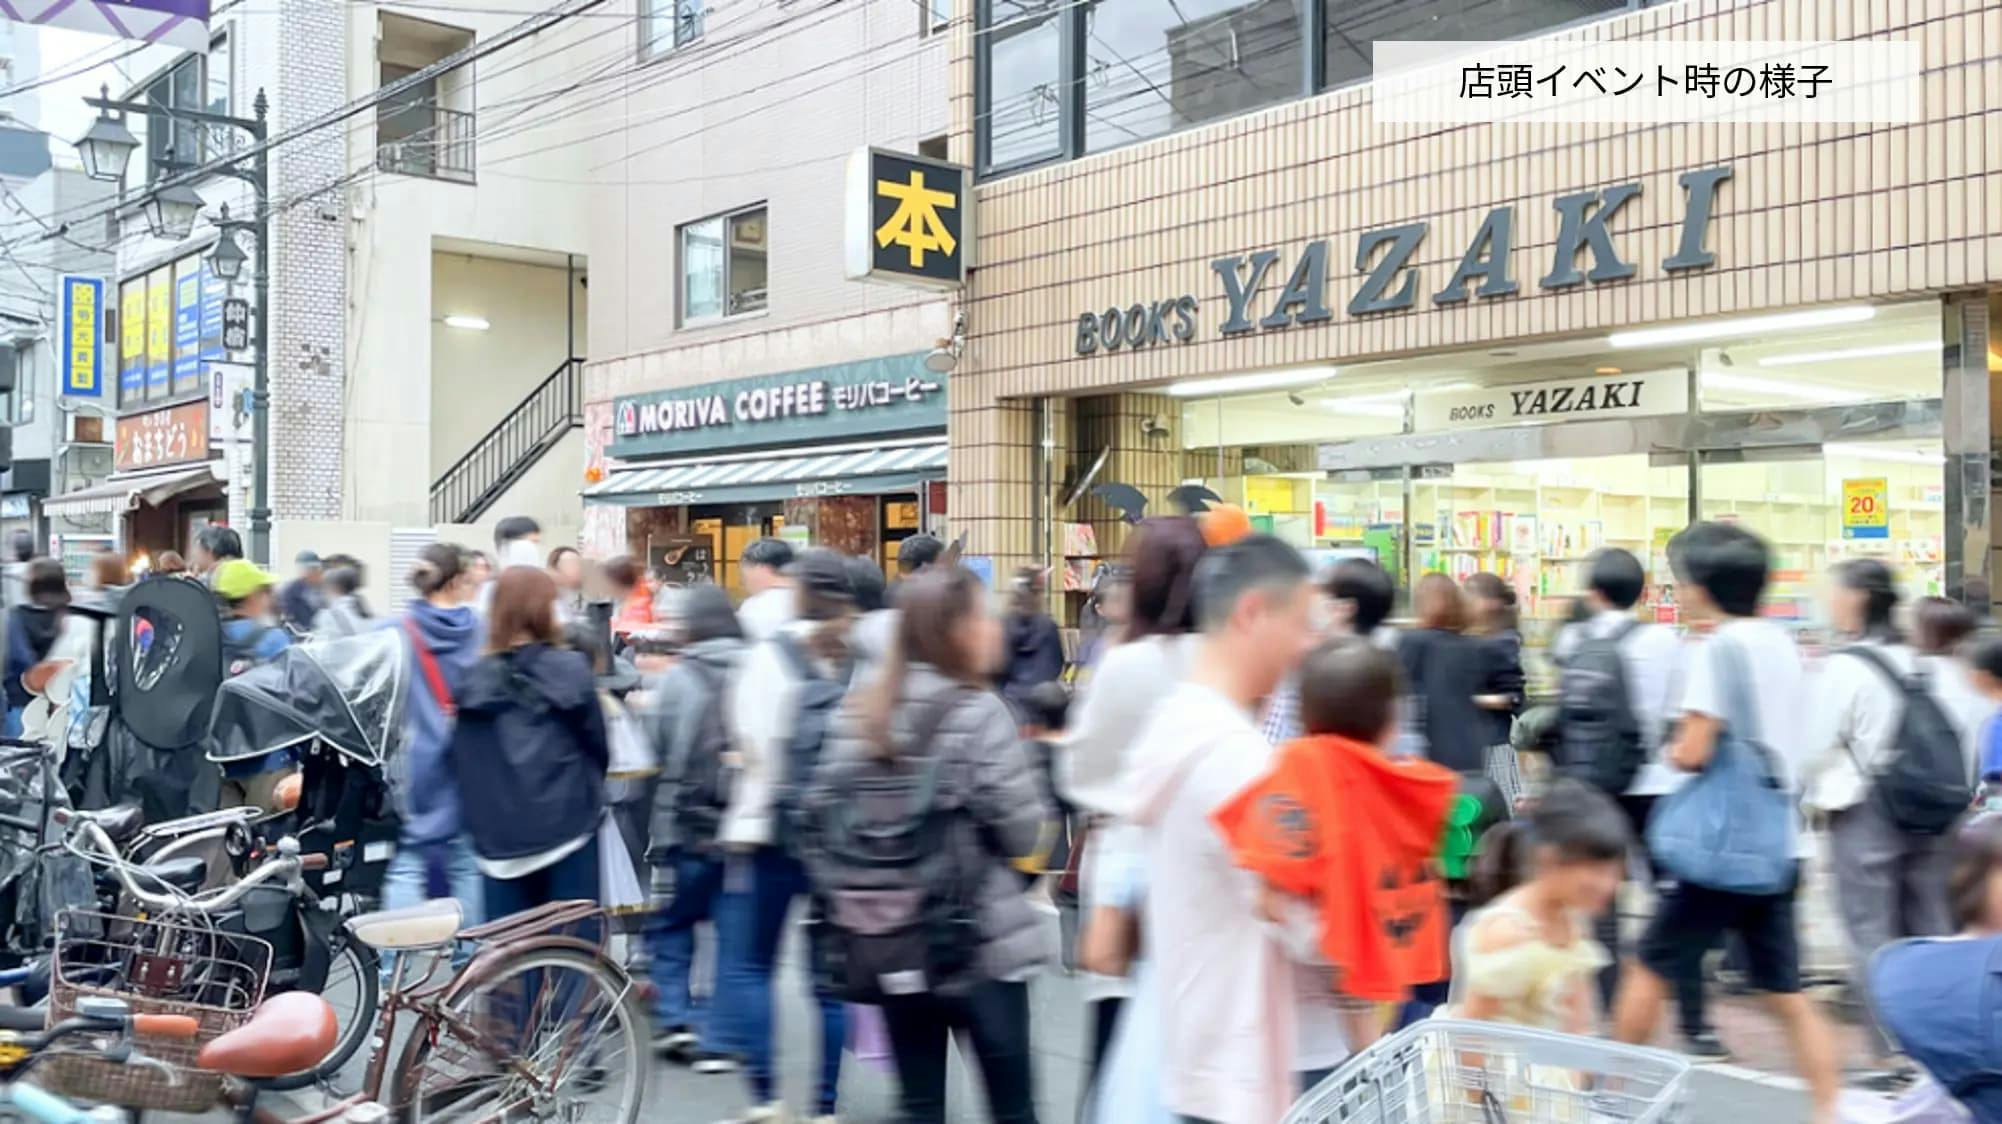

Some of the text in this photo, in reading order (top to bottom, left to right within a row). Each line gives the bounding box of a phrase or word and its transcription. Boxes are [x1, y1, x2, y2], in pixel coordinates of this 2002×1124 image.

[876, 170, 957, 268] 本
[1075, 165, 1735, 354] BOOKS YAZAKI
[639, 376, 940, 432] MORIVA COFFEE モリバコーヒー
[1449, 379, 1645, 422] BOOKS YAZAKI
